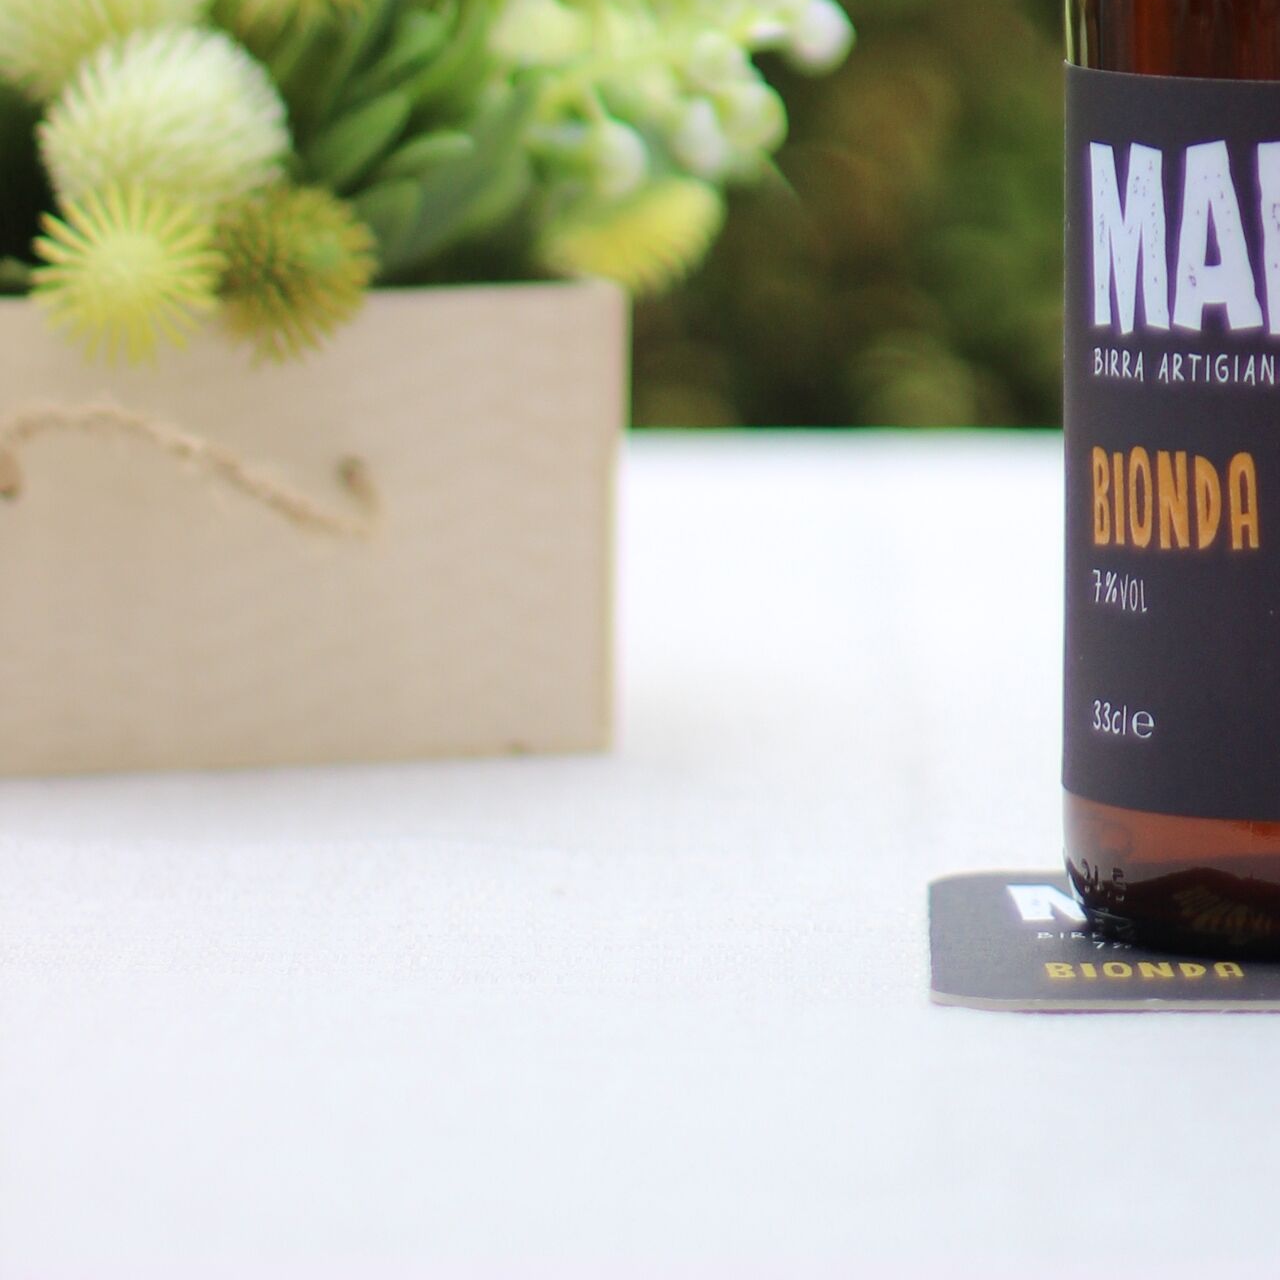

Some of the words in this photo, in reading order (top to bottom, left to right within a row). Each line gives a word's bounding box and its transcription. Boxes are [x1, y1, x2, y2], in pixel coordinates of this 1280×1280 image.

[1093, 347, 1144, 382] BIRRA
[1091, 446, 1259, 550] BIONDA
[1044, 961, 1245, 979] BIONDA
